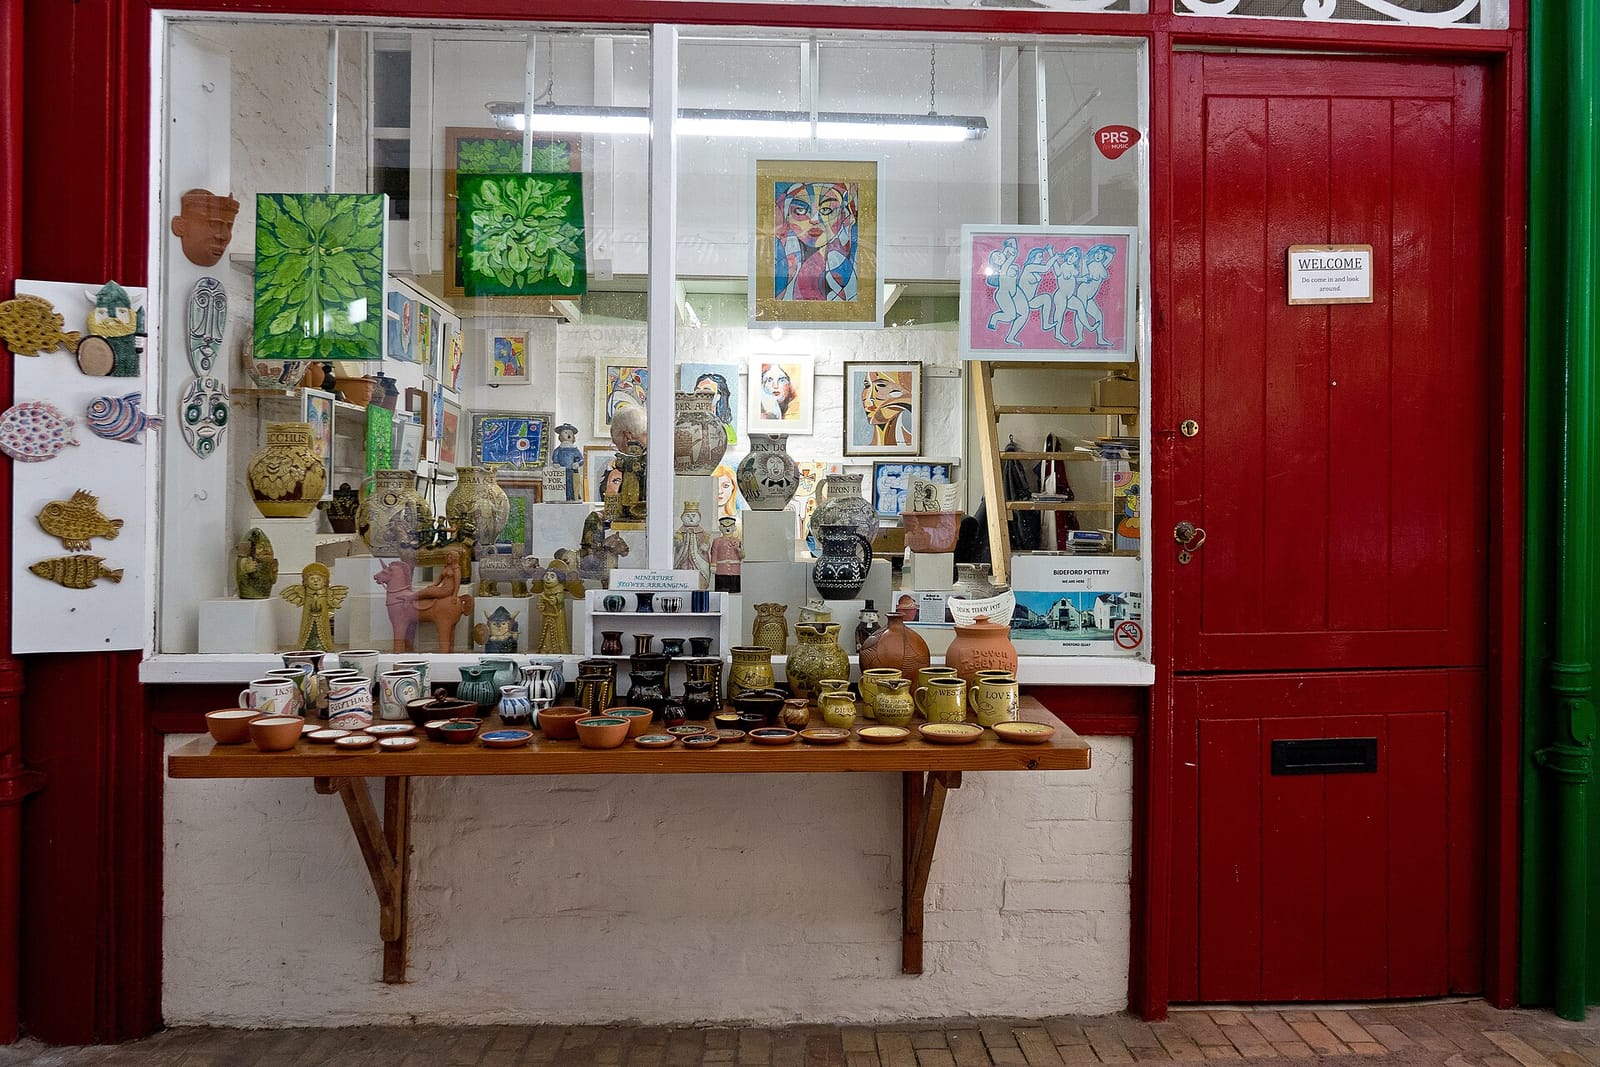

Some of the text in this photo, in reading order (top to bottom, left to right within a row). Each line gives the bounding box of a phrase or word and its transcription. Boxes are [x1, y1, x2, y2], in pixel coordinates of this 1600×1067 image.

[1101, 131, 1129, 144] PRS
[1298, 257, 1362, 270] WELCOME
[973, 648, 1008, 659] Devon
